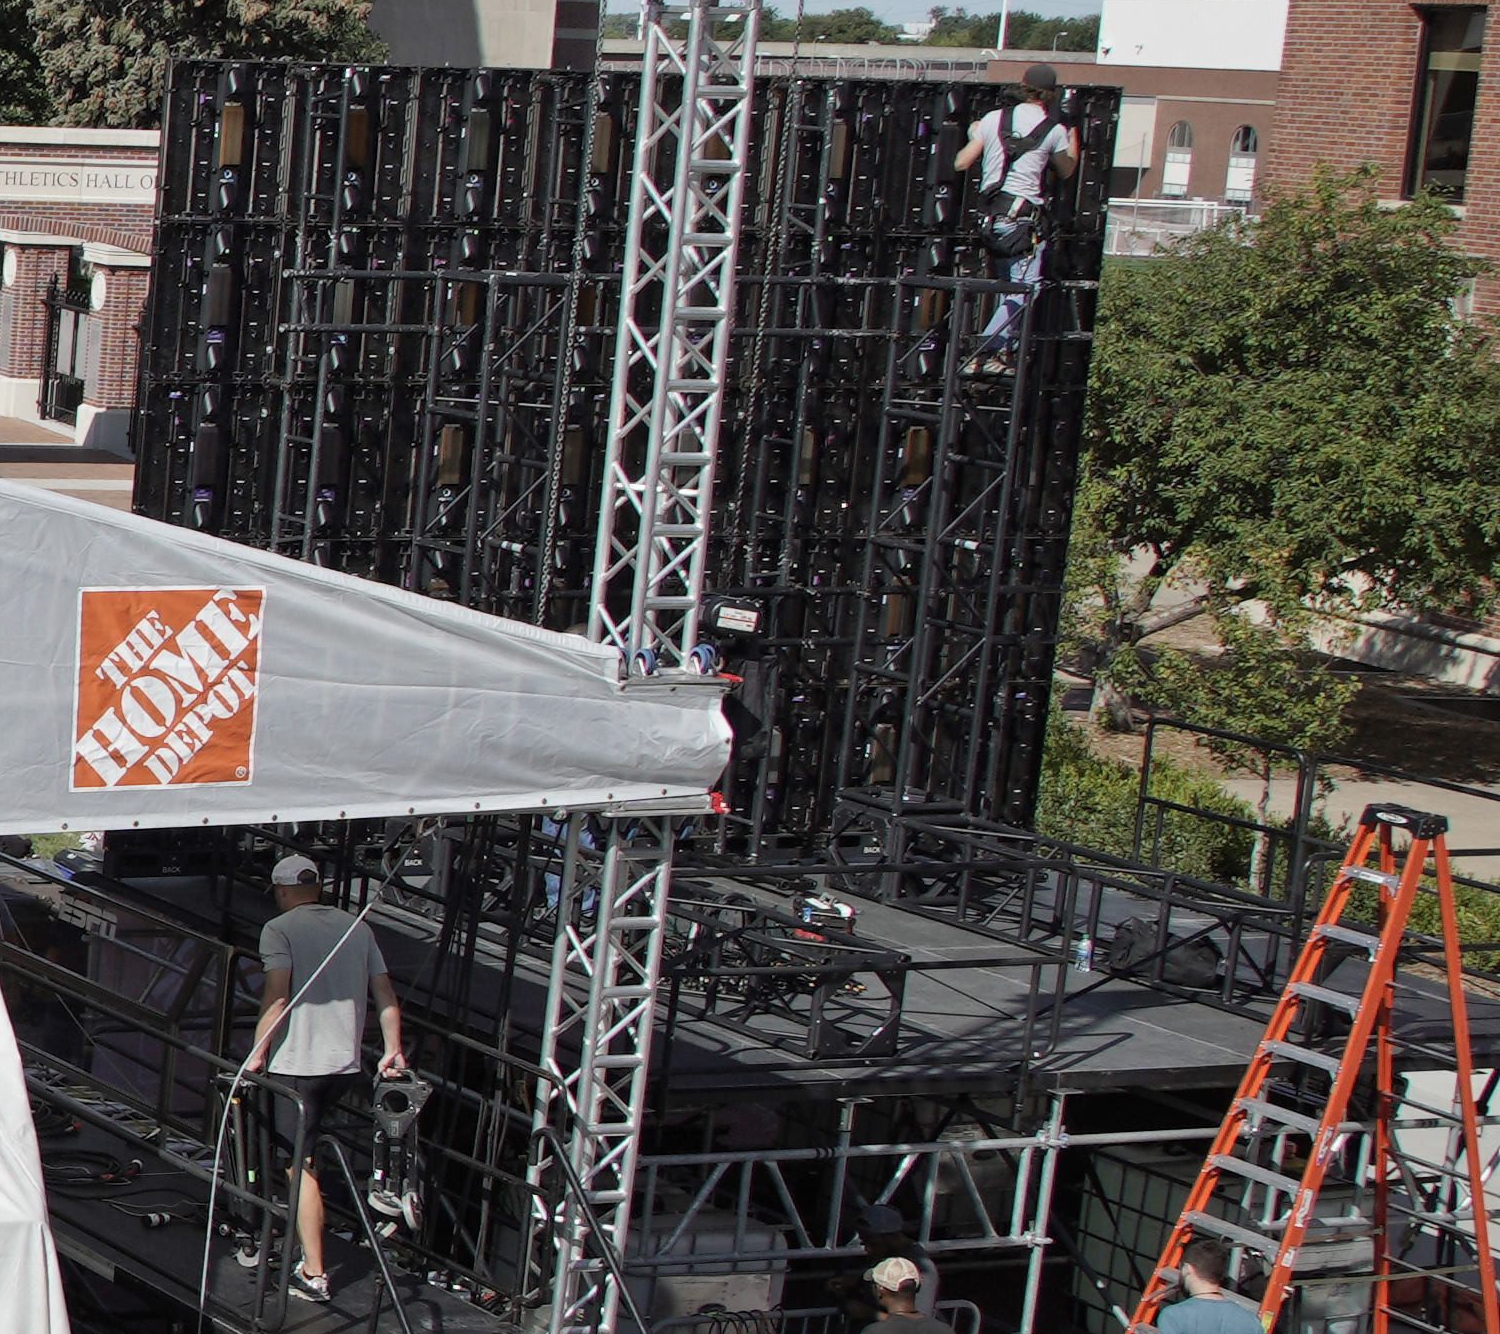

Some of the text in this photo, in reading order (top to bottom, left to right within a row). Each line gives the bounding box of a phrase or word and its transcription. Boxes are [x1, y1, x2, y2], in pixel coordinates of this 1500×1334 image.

[86, 173, 135, 189] HALL
[76, 589, 261, 787] HOME
[95, 610, 173, 689] THE
[143, 660, 258, 785] DEPOT
